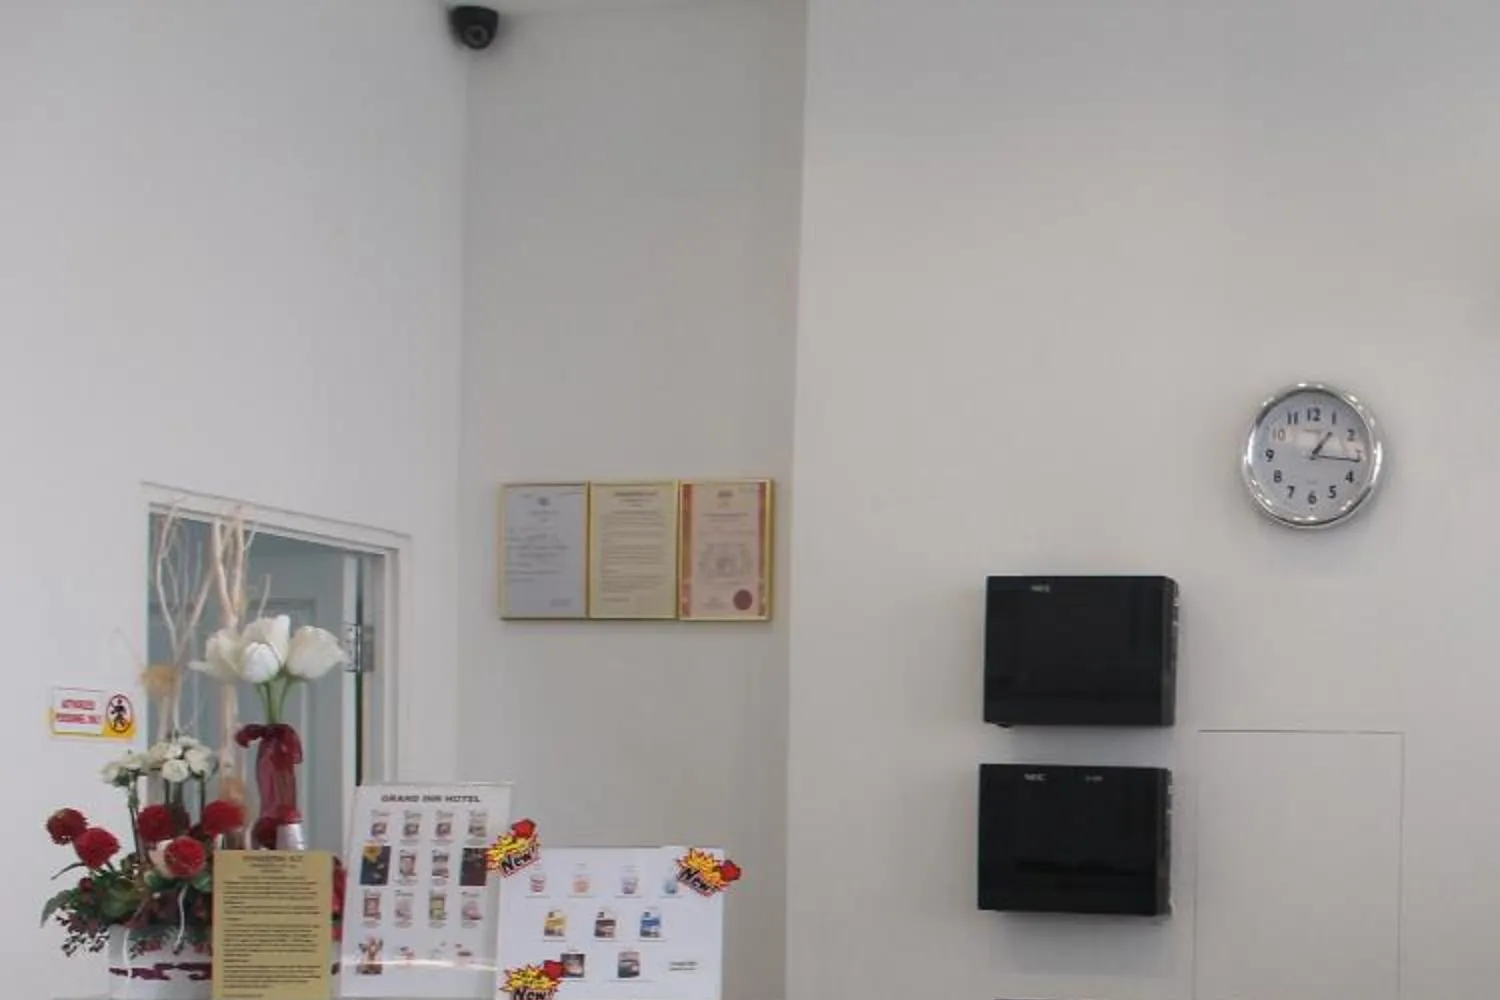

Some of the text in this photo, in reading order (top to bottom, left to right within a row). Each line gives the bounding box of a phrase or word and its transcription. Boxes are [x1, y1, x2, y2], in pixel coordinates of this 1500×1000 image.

[1287, 411, 1299, 425] 11
[1307, 407, 1321, 422] 12
[1331, 411, 1337, 425] 1
[1272, 428, 1286, 441] 10
[1347, 429, 1355, 442] 2
[1265, 449, 1275, 462] 9
[1273, 470, 1282, 483] 8
[1345, 471, 1354, 483] 4
[1287, 485, 1296, 498] 7
[1308, 491, 1317, 504] 6
[1328, 485, 1337, 498] 5
[381, 795, 420, 803] GRAND
[445, 795, 481, 804] HOTEL
